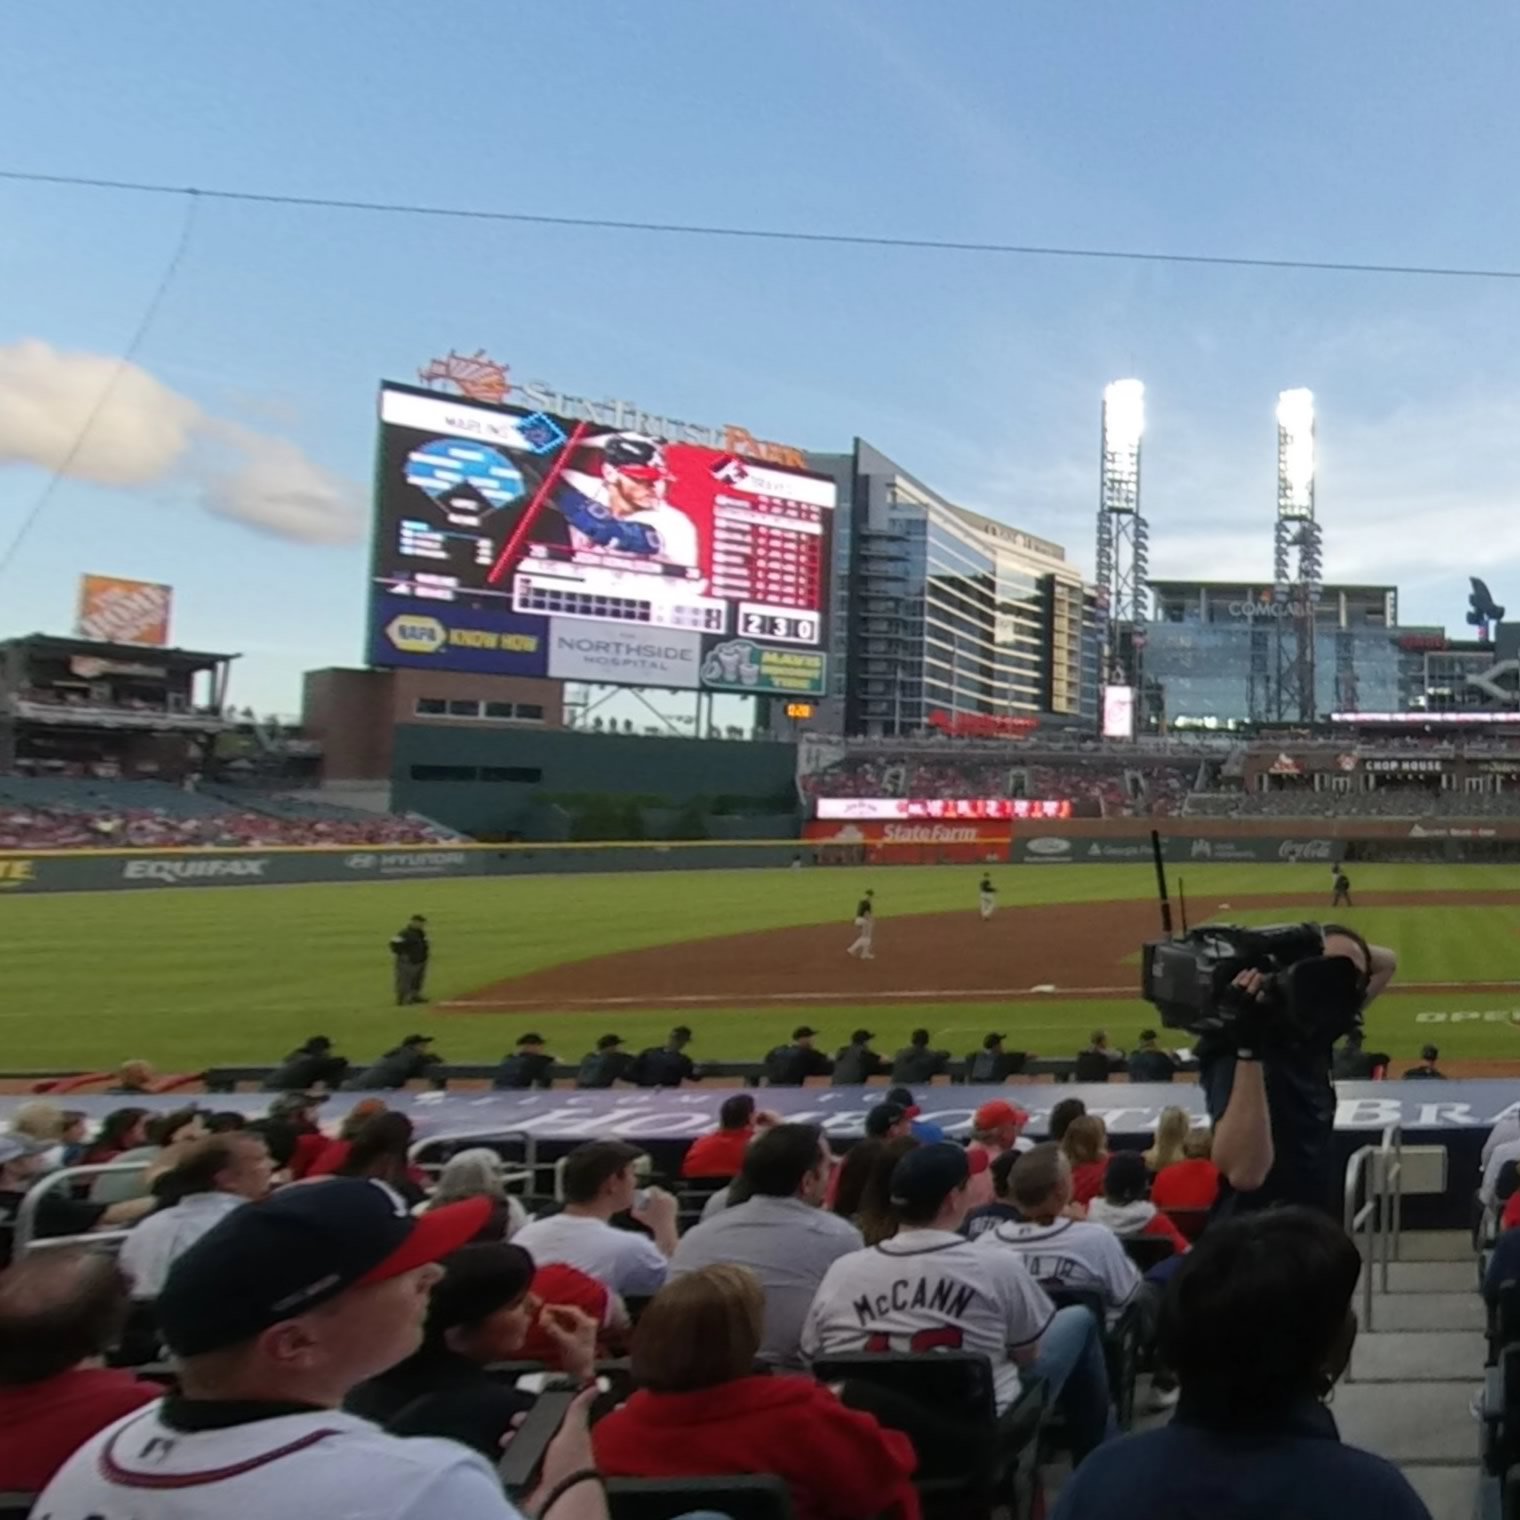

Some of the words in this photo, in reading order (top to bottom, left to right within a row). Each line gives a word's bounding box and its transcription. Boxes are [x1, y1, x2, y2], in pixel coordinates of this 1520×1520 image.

[397, 621, 437, 642] NAPA
[450, 628, 497, 649] KNOW
[500, 634, 538, 652] HOW
[747, 615, 761, 633] 2
[797, 621, 811, 639] 0
[557, 636, 693, 662] NORTHSIDE
[584, 656, 667, 671] HOSPITAL
[1366, 761, 1397, 771] CHOP
[1402, 761, 1442, 771] HOUSE
[123, 858, 270, 882] EQUIFAX
[853, 1276, 976, 1327] McCANN
